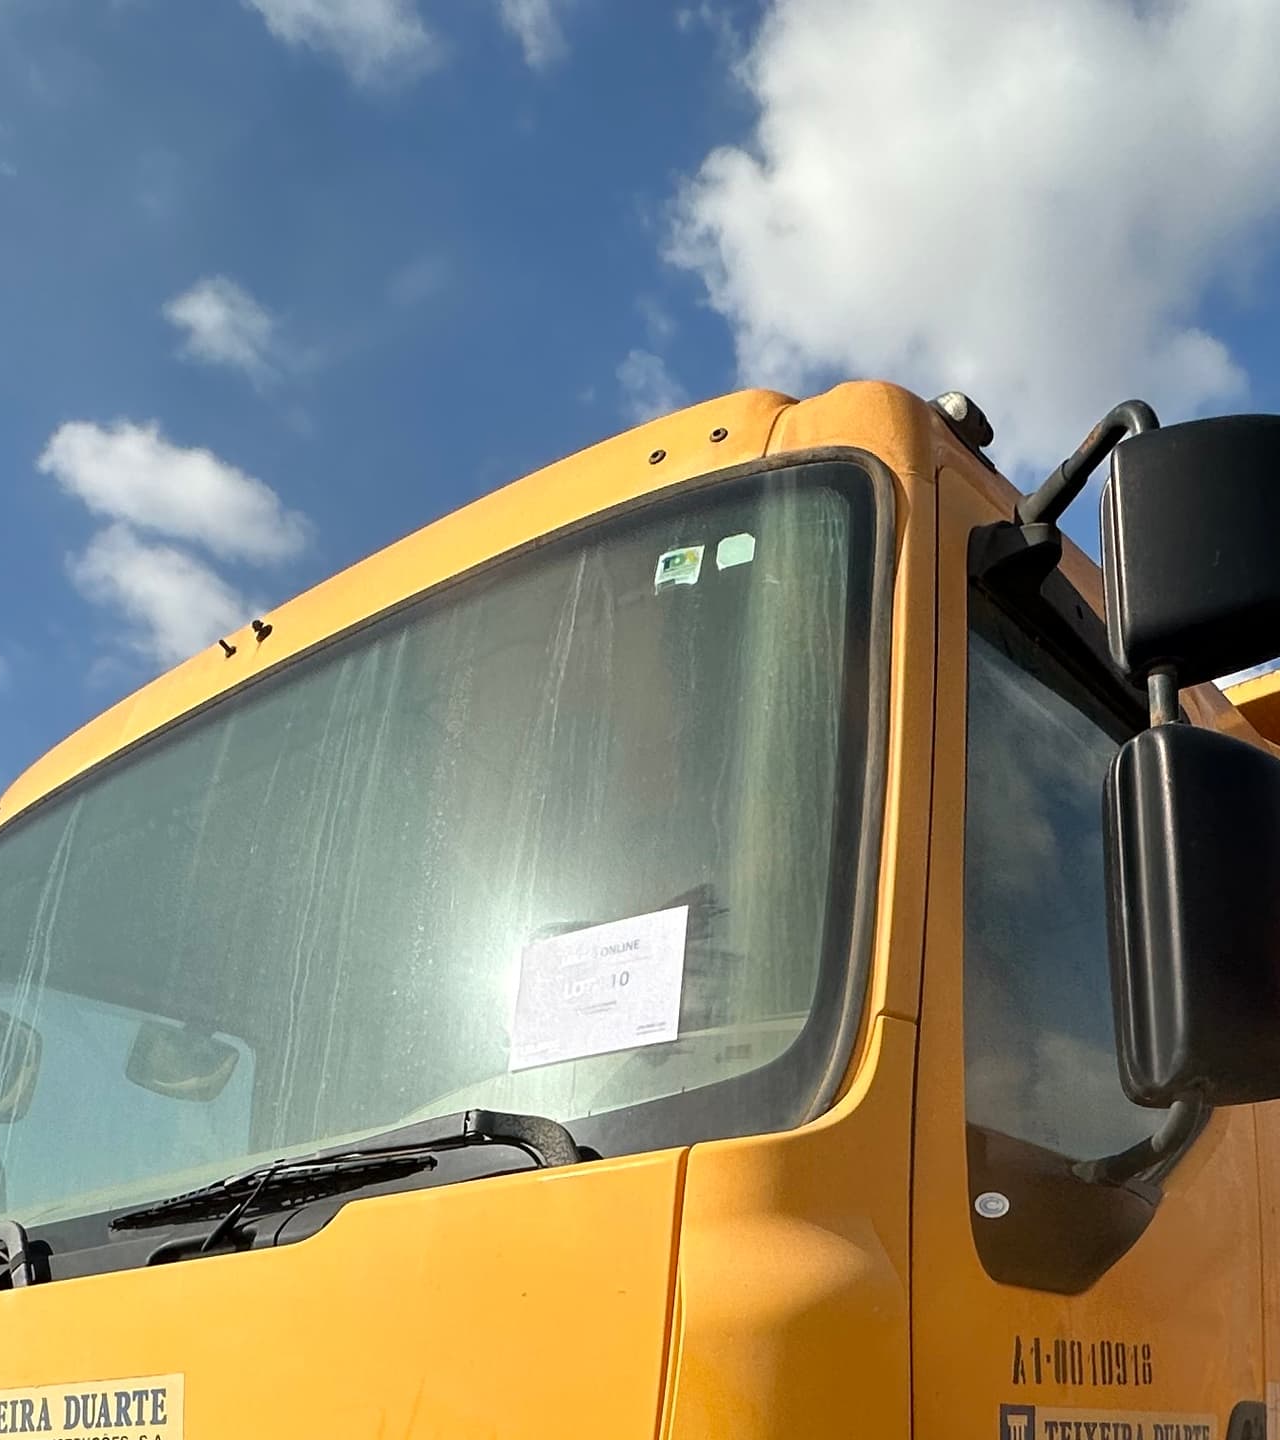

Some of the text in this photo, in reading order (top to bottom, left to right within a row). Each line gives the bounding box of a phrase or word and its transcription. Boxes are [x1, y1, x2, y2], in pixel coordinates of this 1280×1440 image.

[599, 939, 640, 957] ONLINE
[611, 970, 630, 988] 10
[63, 1388, 167, 1430] DUARTE
